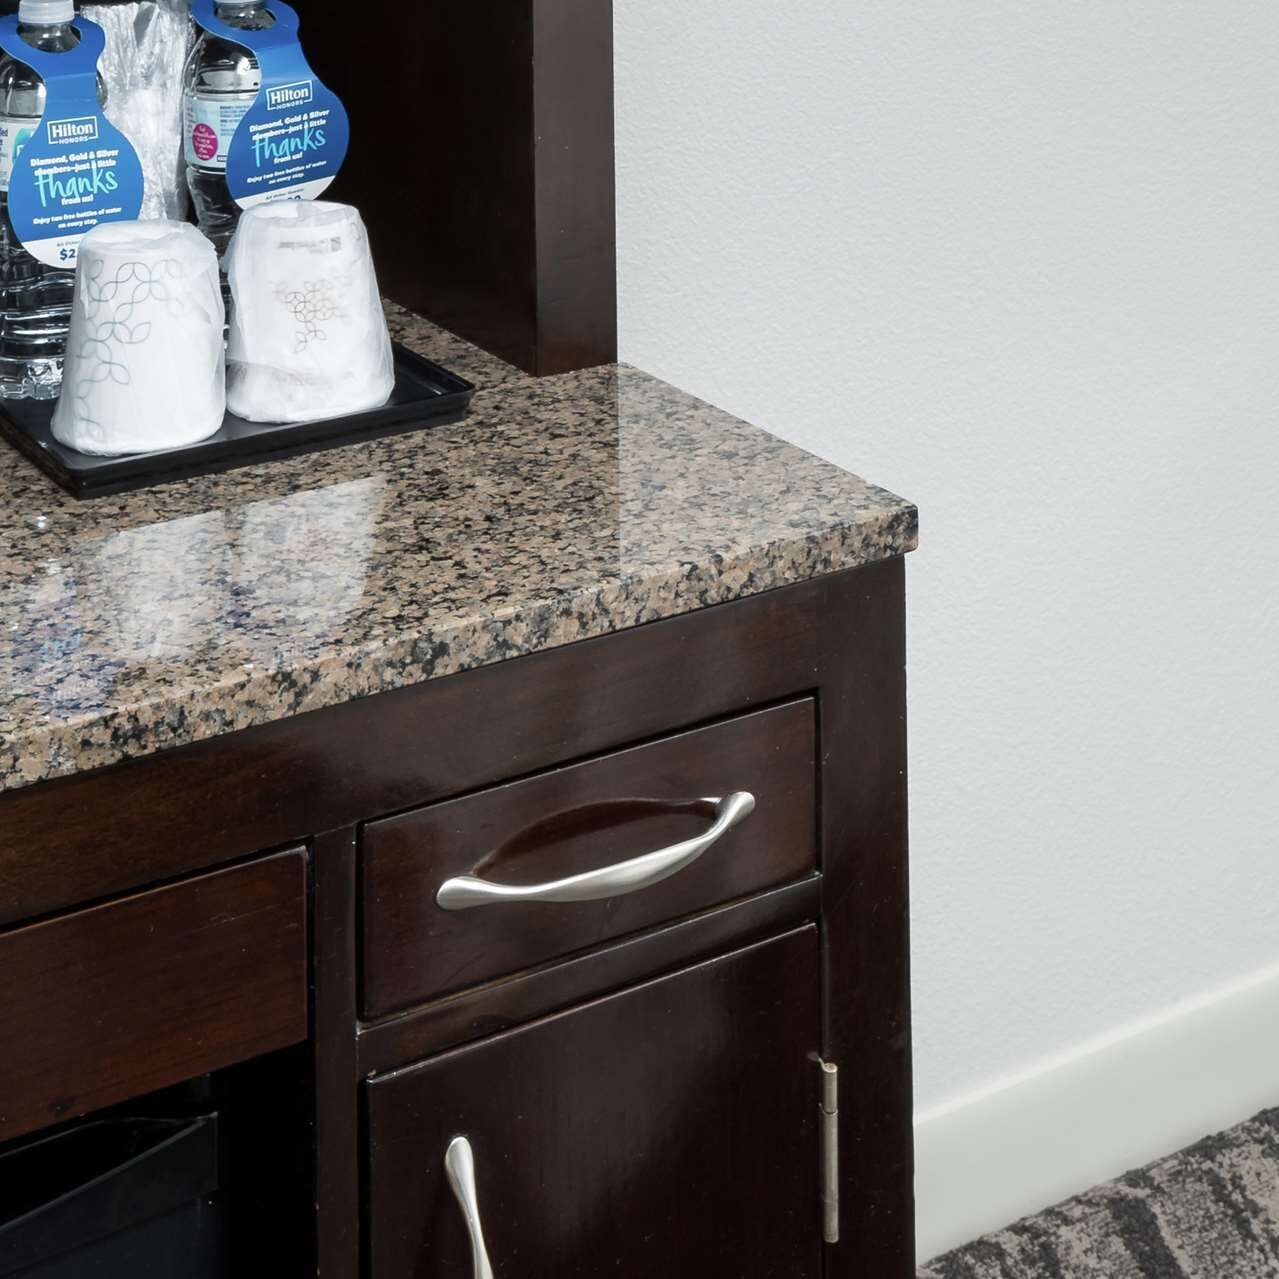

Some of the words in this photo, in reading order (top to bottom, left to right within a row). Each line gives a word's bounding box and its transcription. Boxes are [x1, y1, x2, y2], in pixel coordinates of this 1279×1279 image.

[270, 88, 309, 104] Hilton
[276, 100, 304, 109] HONORS
[249, 119, 284, 132] Diamond,
[284, 115, 301, 124] Gold
[309, 110, 330, 119] Silver
[51, 123, 94, 138] Hilton
[58, 136, 89, 144] HONORS
[30, 154, 68, 167] Diamond,
[69, 152, 88, 162] Gold
[96, 149, 119, 158] Silver
[97, 159, 116, 168] little
[33, 217, 50, 225] Enjoy
